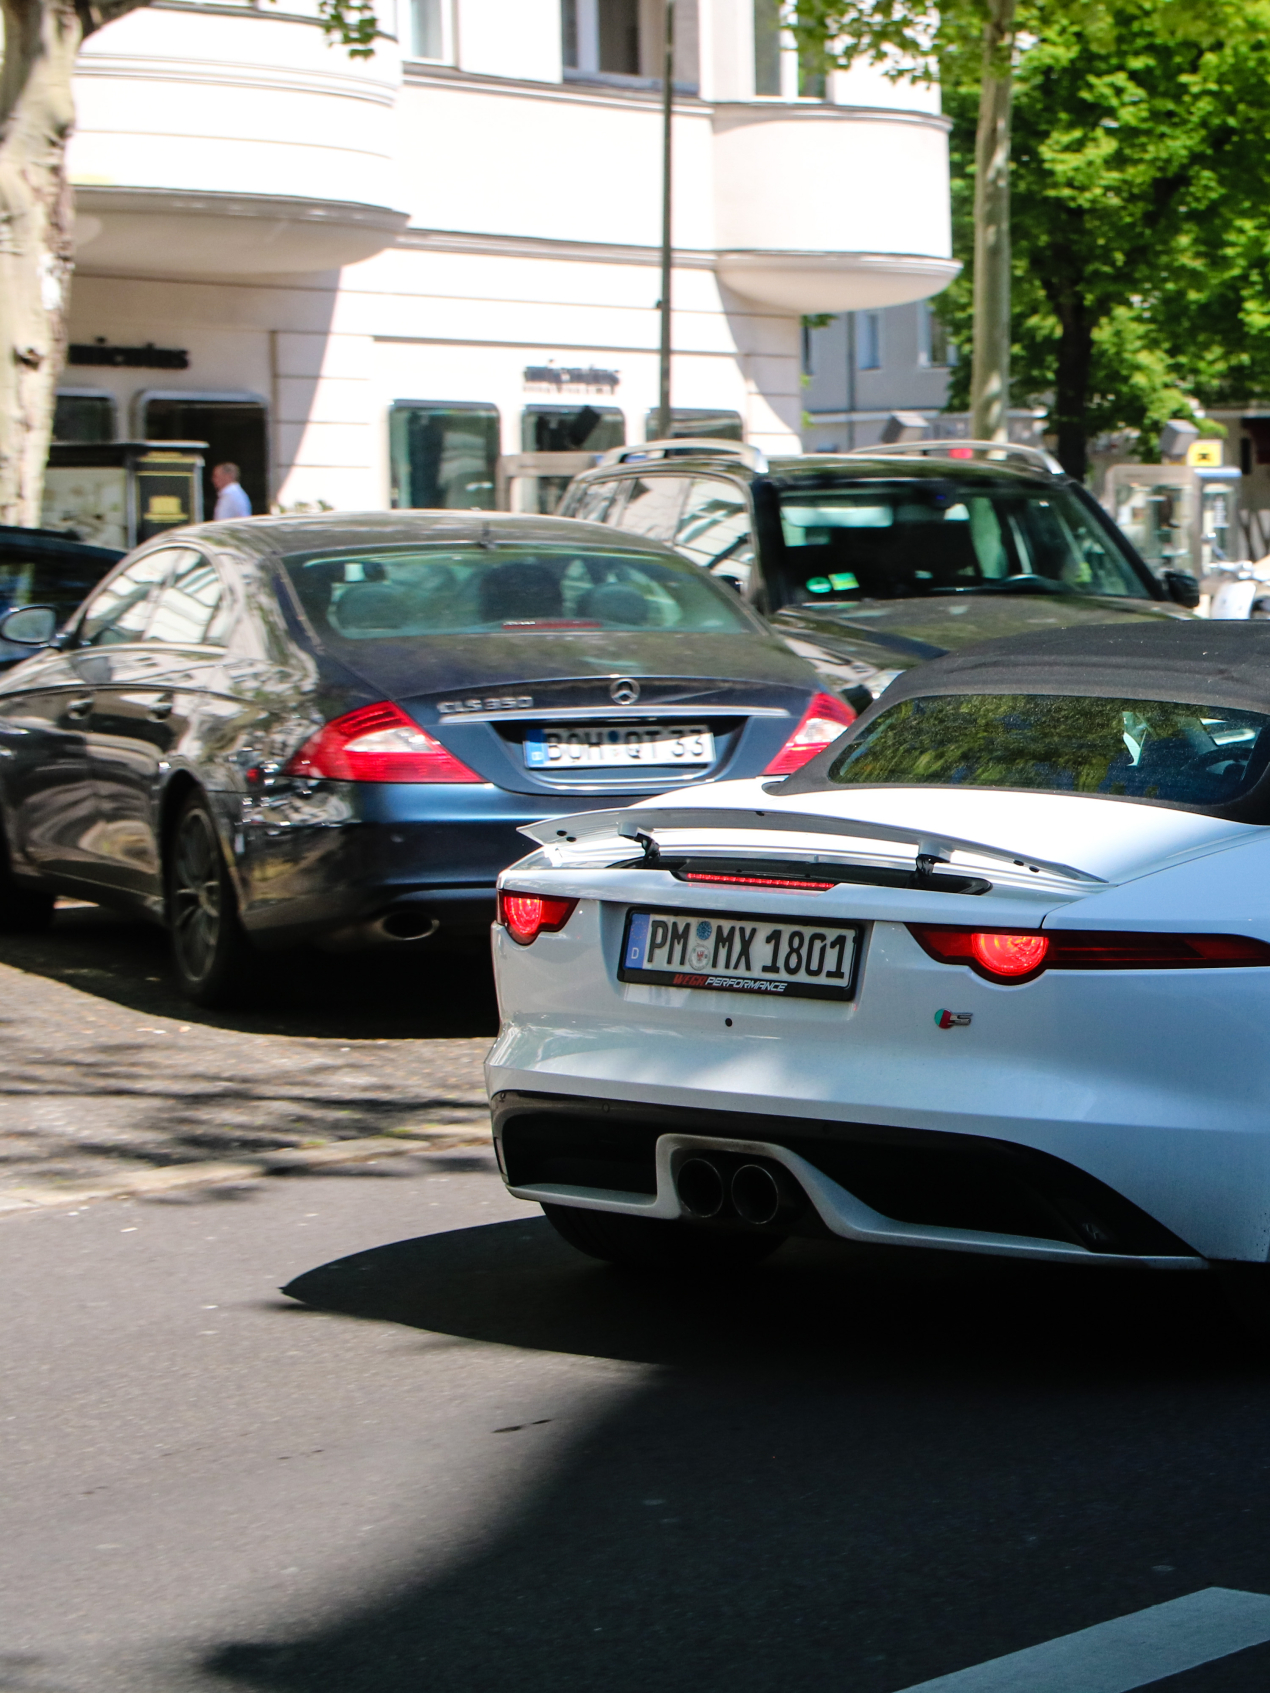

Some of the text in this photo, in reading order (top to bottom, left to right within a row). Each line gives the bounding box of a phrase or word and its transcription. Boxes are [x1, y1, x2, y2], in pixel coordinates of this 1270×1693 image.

[547, 732, 602, 762] BOH
[624, 729, 659, 757] QT
[669, 728, 706, 757] 33
[631, 946, 640, 961] D
[647, 920, 847, 979] PM MX 1801
